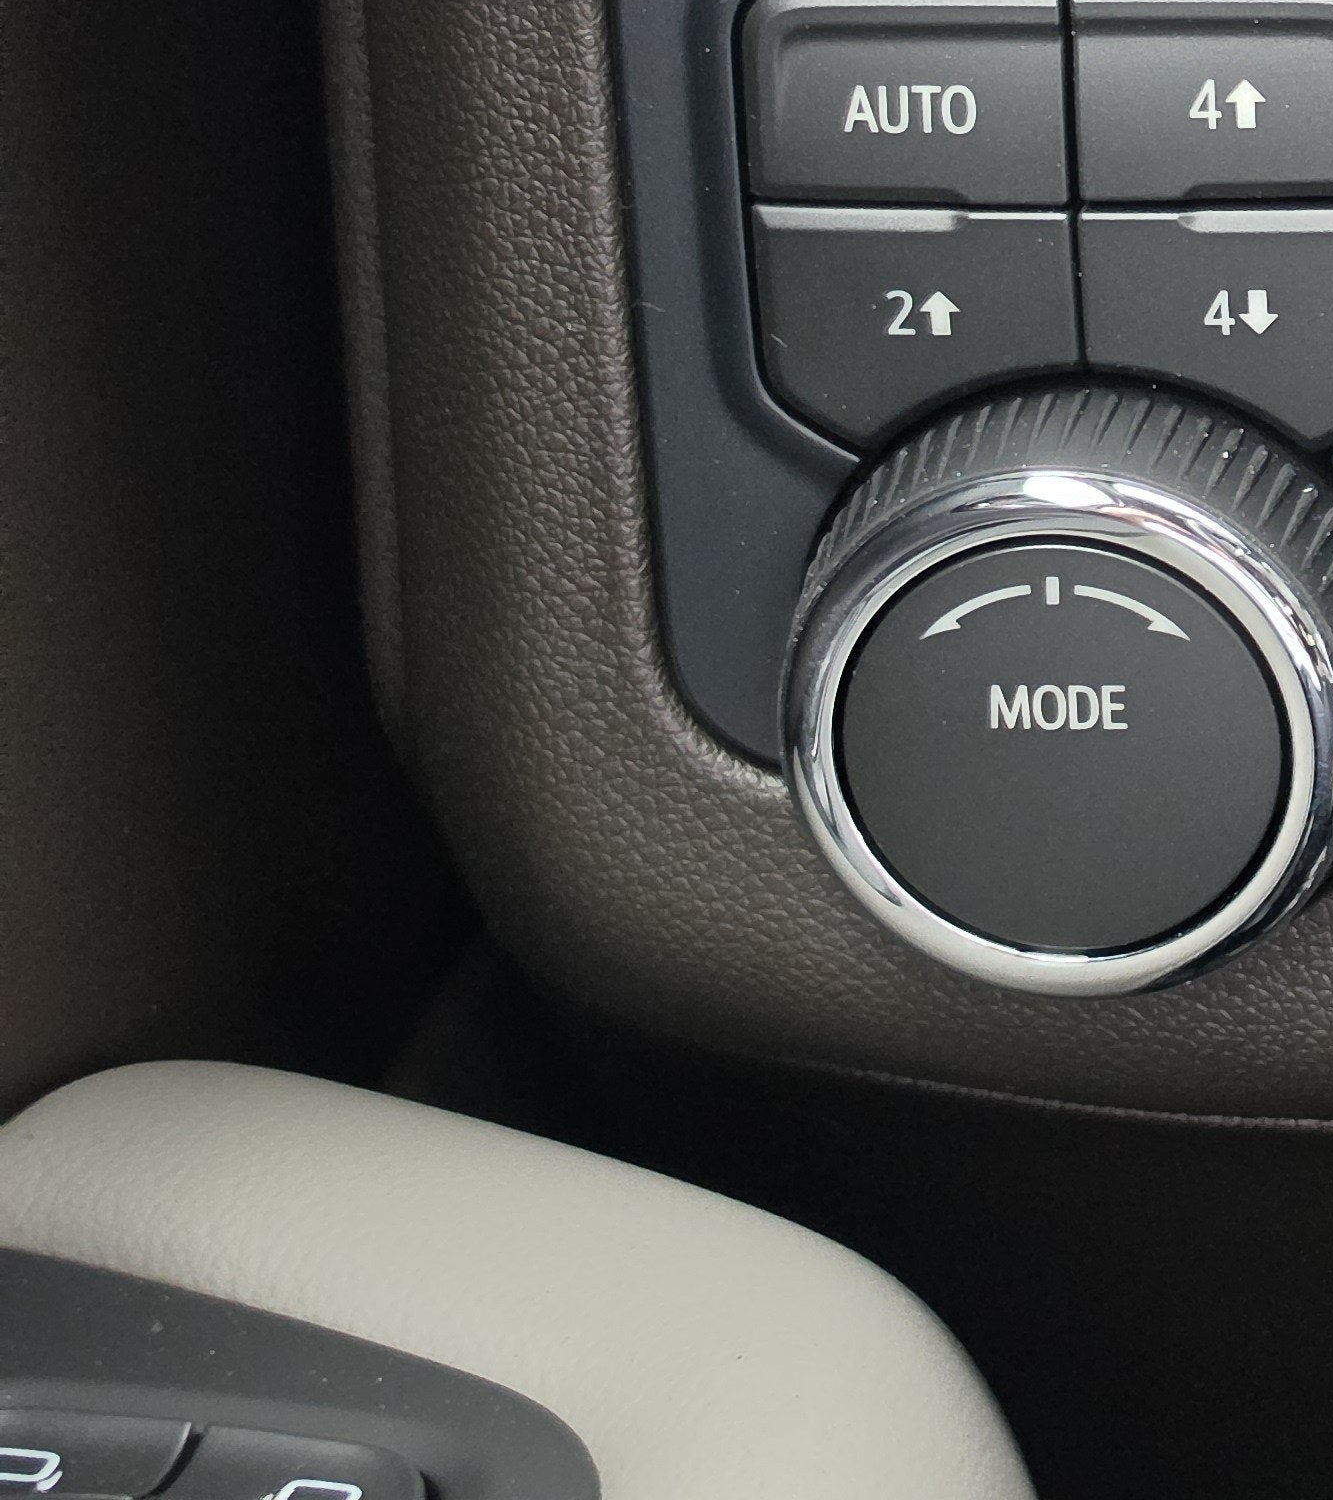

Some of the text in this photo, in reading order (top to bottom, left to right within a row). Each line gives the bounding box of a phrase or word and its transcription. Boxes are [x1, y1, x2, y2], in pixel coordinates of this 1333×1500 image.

[843, 85, 977, 135] AUTO
[1189, 79, 1222, 130] 4
[885, 289, 916, 336] 2
[1203, 289, 1235, 336] 4
[990, 684, 1129, 731] MODE
